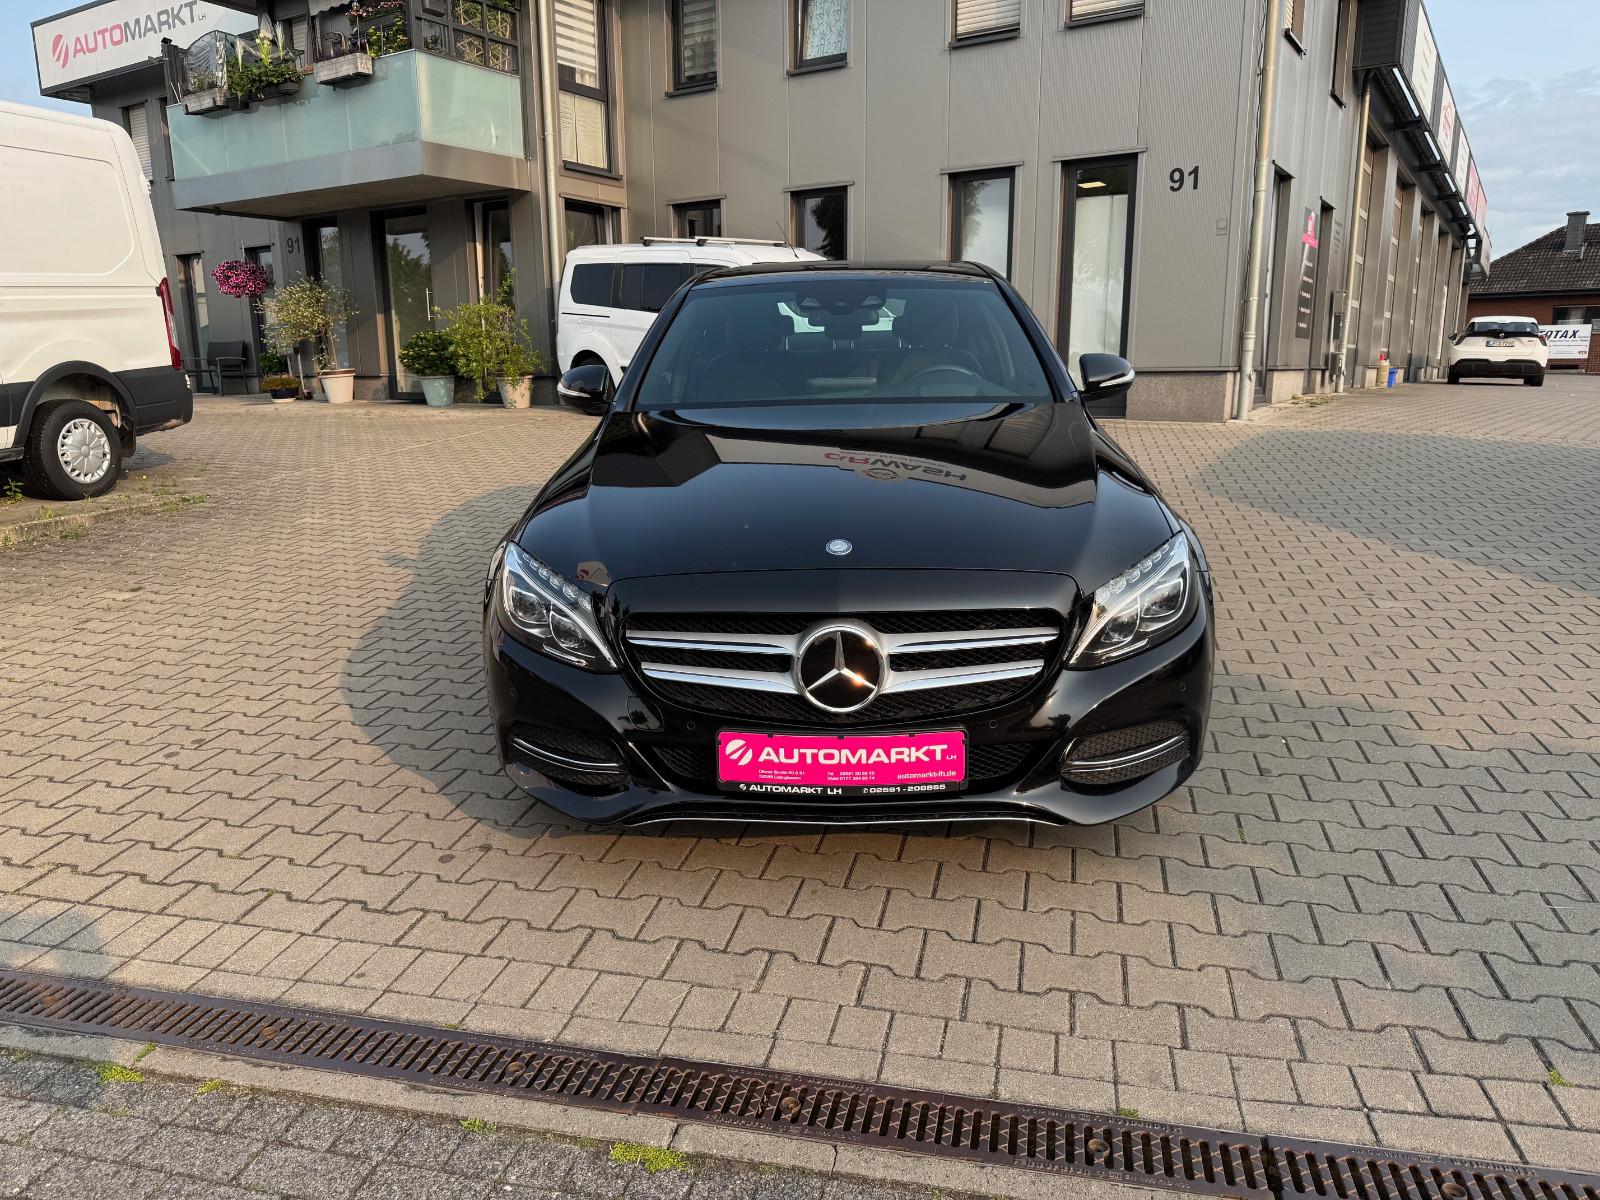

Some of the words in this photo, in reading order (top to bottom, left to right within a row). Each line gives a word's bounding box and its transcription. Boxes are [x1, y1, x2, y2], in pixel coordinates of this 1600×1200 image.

[72, 0, 198, 59] AUTOMARKT
[1168, 165, 1200, 192] 91
[286, 237, 300, 254] 91
[757, 744, 948, 765] AUTOMARKT
[897, 769, 957, 780] automarkt-lh.de
[749, 784, 823, 794] AUTOMARKT
[827, 787, 842, 795] LH
